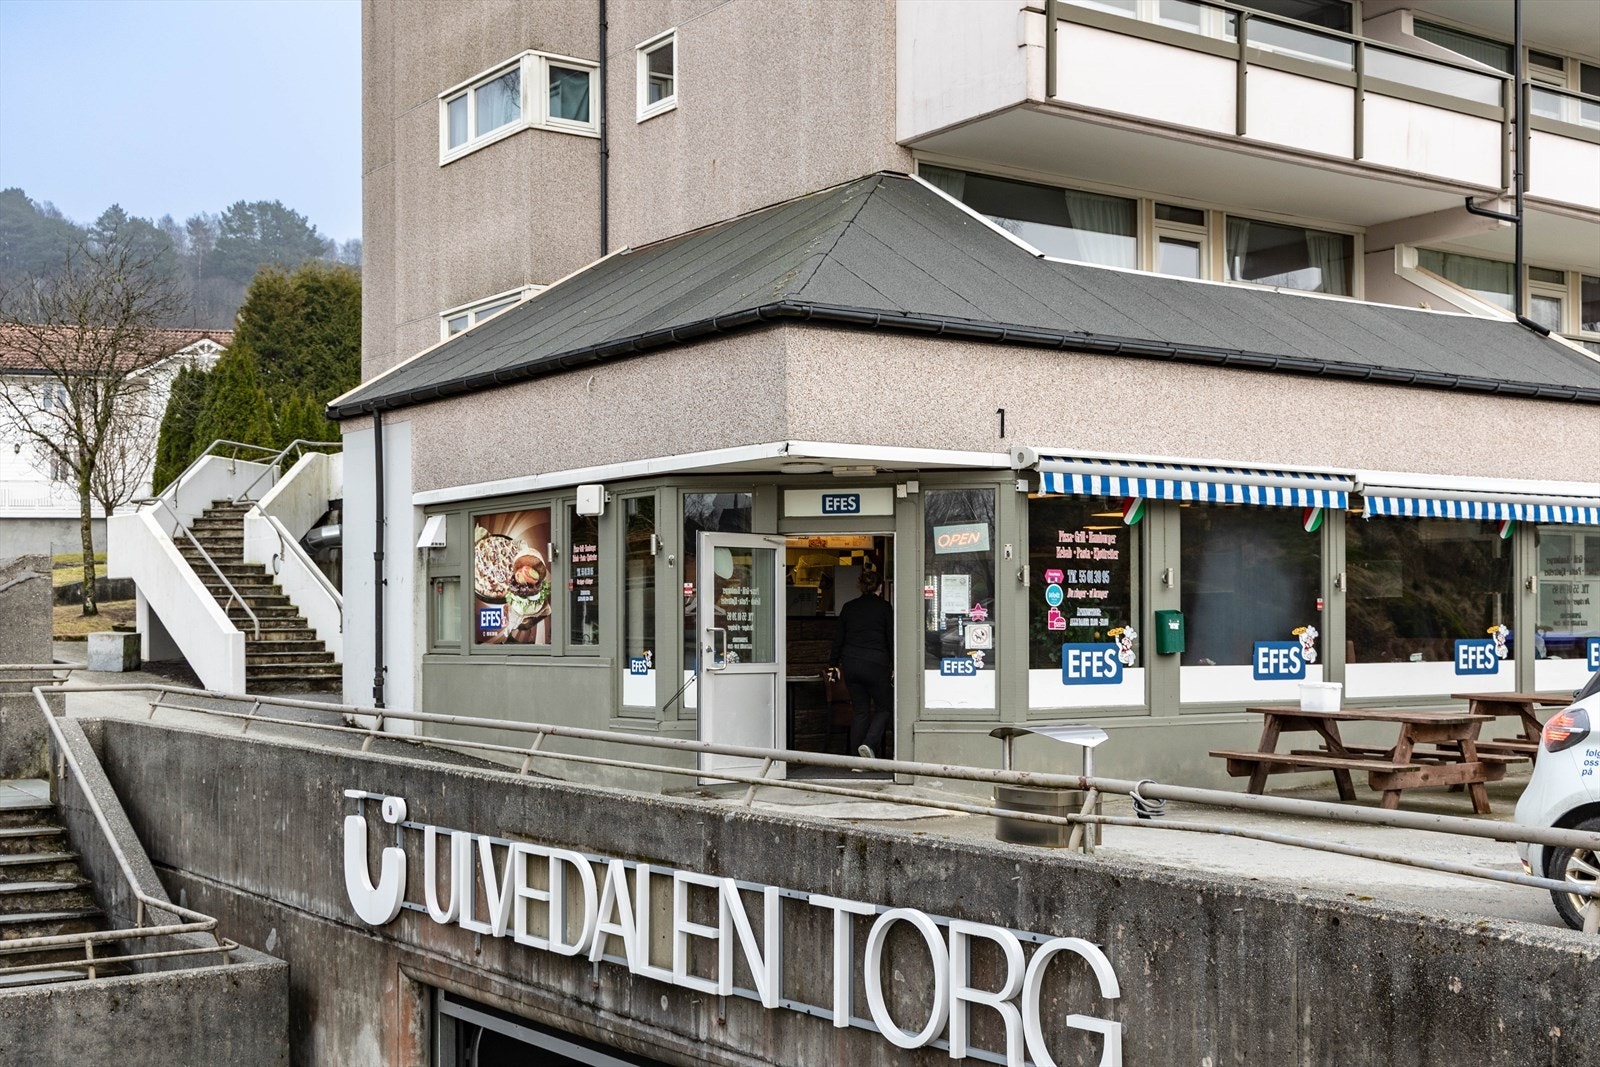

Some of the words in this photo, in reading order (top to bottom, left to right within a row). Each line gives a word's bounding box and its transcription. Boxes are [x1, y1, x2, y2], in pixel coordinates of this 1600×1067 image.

[996, 408, 1005, 438] 1
[825, 496, 857, 511] EFES
[937, 531, 981, 548] OPEN
[480, 611, 501, 627] EFES
[1067, 648, 1118, 679] EFES
[1258, 646, 1301, 675] EFES
[1458, 644, 1495, 670] EFES
[632, 659, 647, 673] EFES
[943, 659, 974, 674] EFES
[1581, 767, 1593, 777] på
[424, 825, 779, 1008] ULVEDALEN
[808, 894, 1122, 1067] TORG
